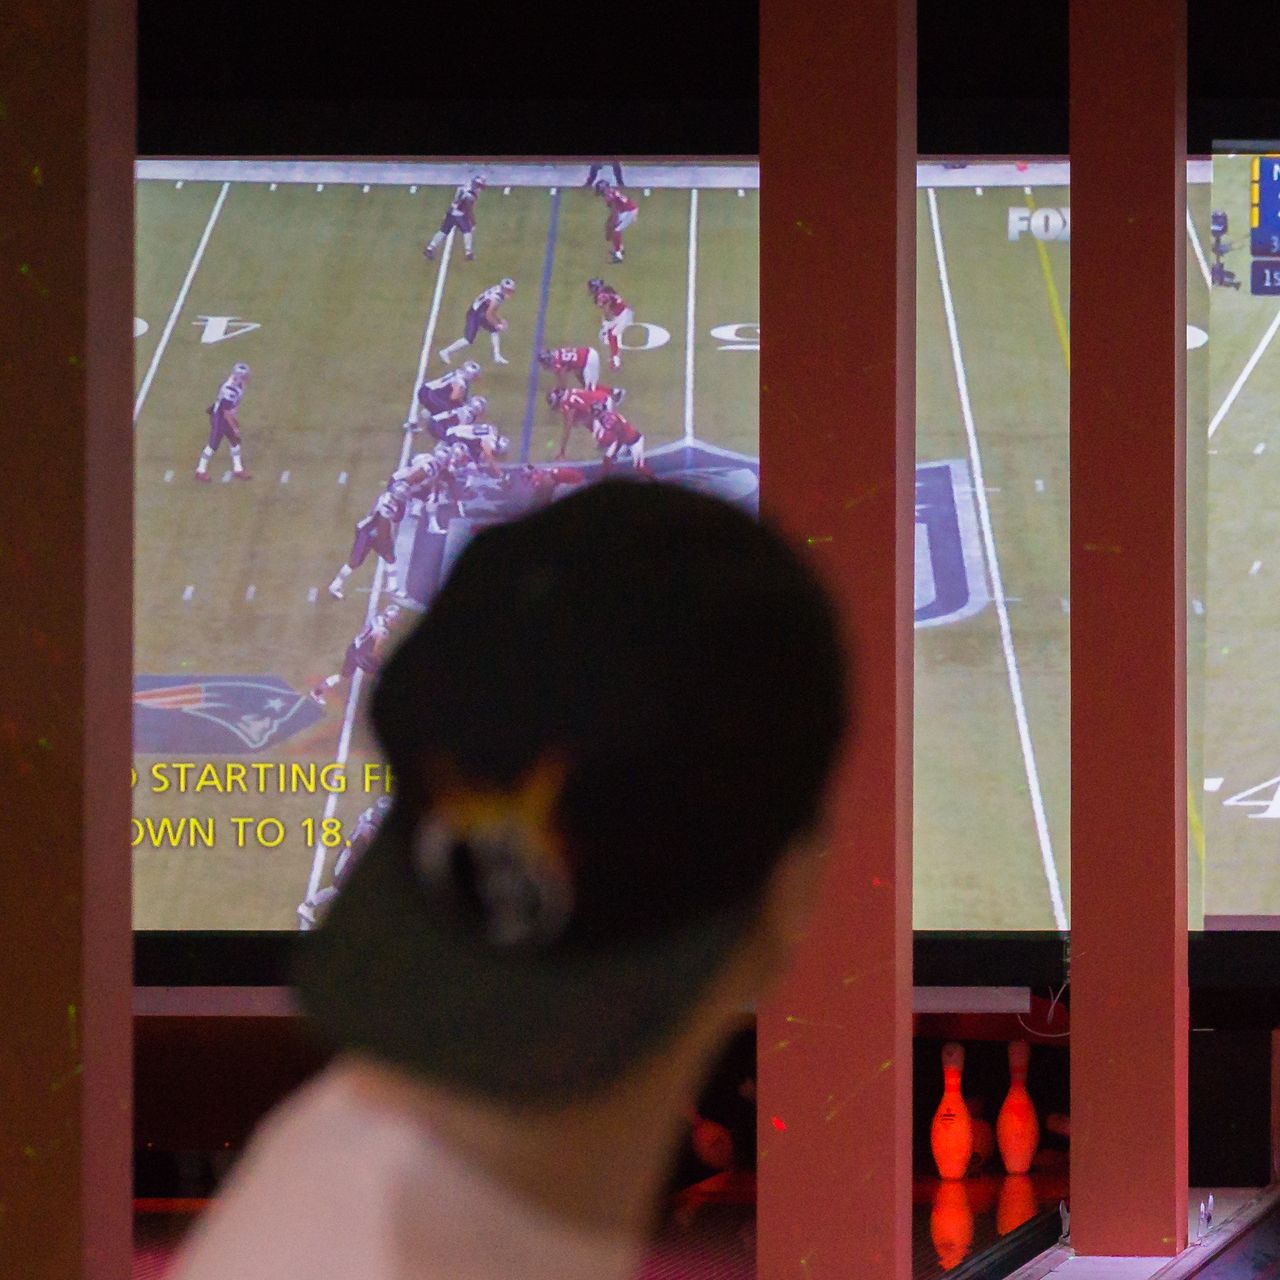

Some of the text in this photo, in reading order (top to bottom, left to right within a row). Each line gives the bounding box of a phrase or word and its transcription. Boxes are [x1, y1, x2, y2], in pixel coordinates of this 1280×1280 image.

[152, 763, 346, 793] STARTING
[231, 818, 285, 847] TO
[301, 818, 351, 847] 18.
